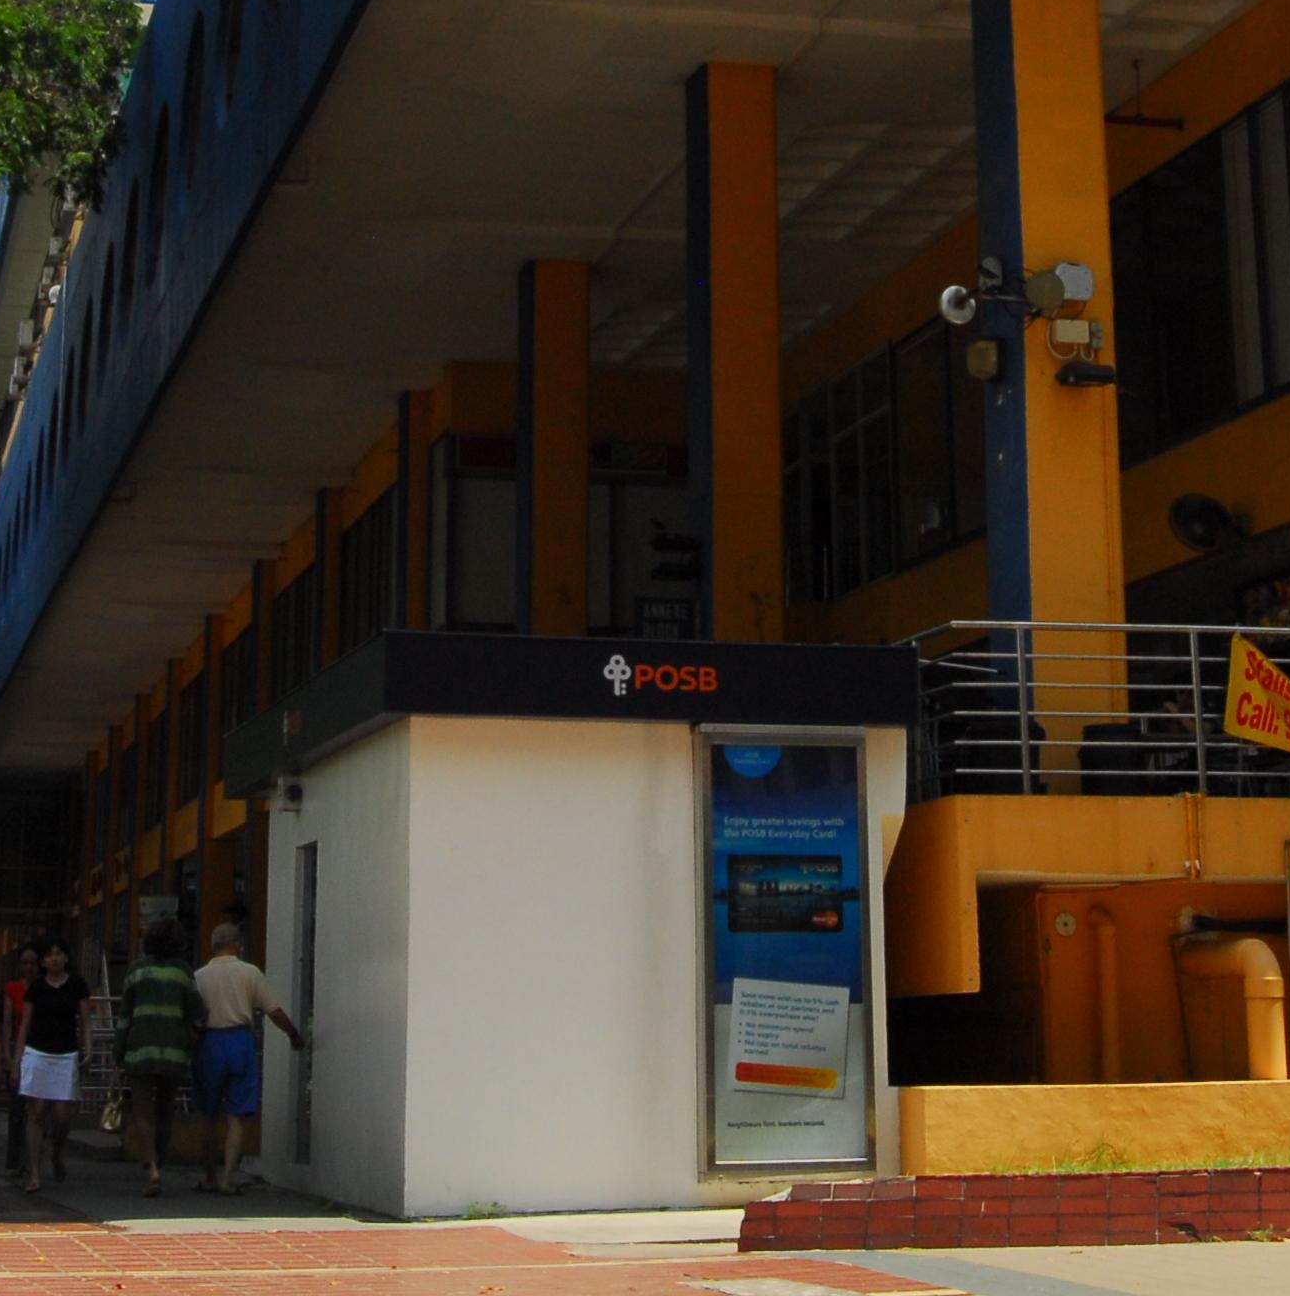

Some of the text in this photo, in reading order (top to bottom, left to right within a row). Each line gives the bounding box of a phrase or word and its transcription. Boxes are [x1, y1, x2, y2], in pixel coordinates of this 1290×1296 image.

[634, 663, 718, 692] POSB
[1236, 691, 1279, 735] Call:
[724, 815, 845, 829] Enjoy greater savings with
[724, 828, 740, 838] the
[742, 828, 767, 838] POSB
[768, 829, 810, 840] Everyday
